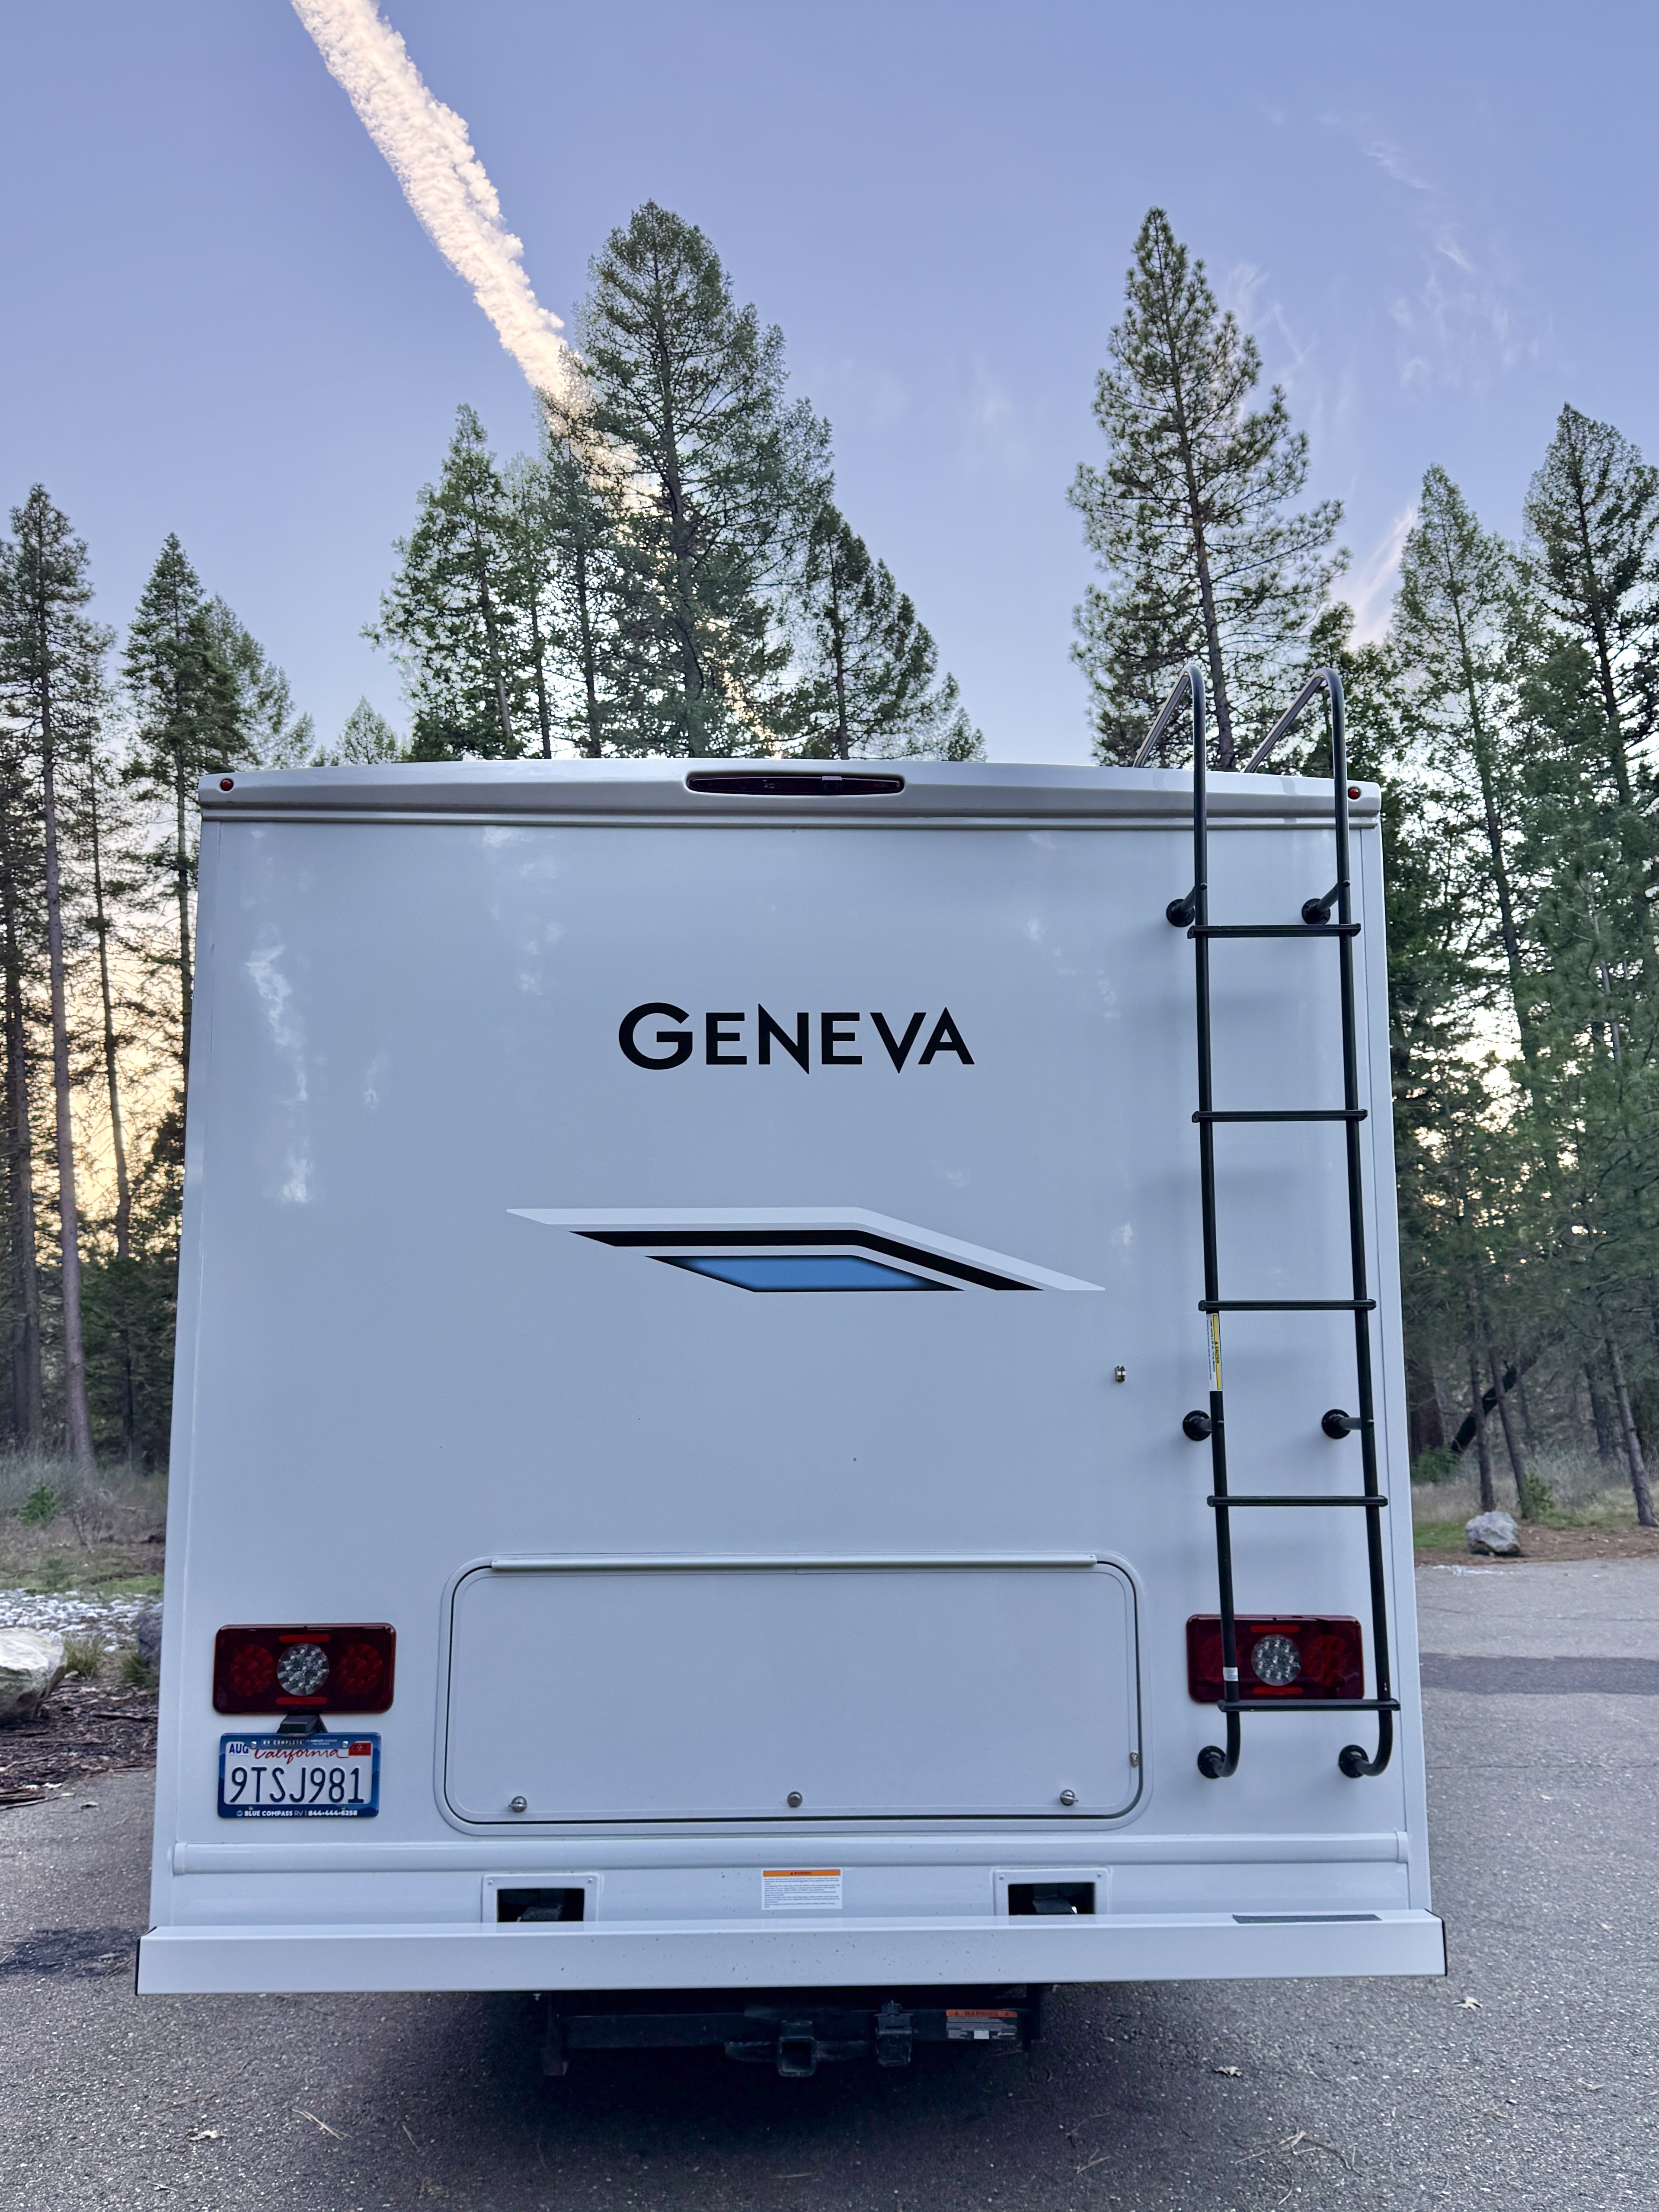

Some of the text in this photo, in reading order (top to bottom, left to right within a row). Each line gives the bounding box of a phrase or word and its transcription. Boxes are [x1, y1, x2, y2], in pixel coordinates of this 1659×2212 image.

[619, 1002, 975, 1074] GENEVA
[229, 1743, 249, 1754] AUG
[230, 1767, 364, 1803] 9TSJ981
